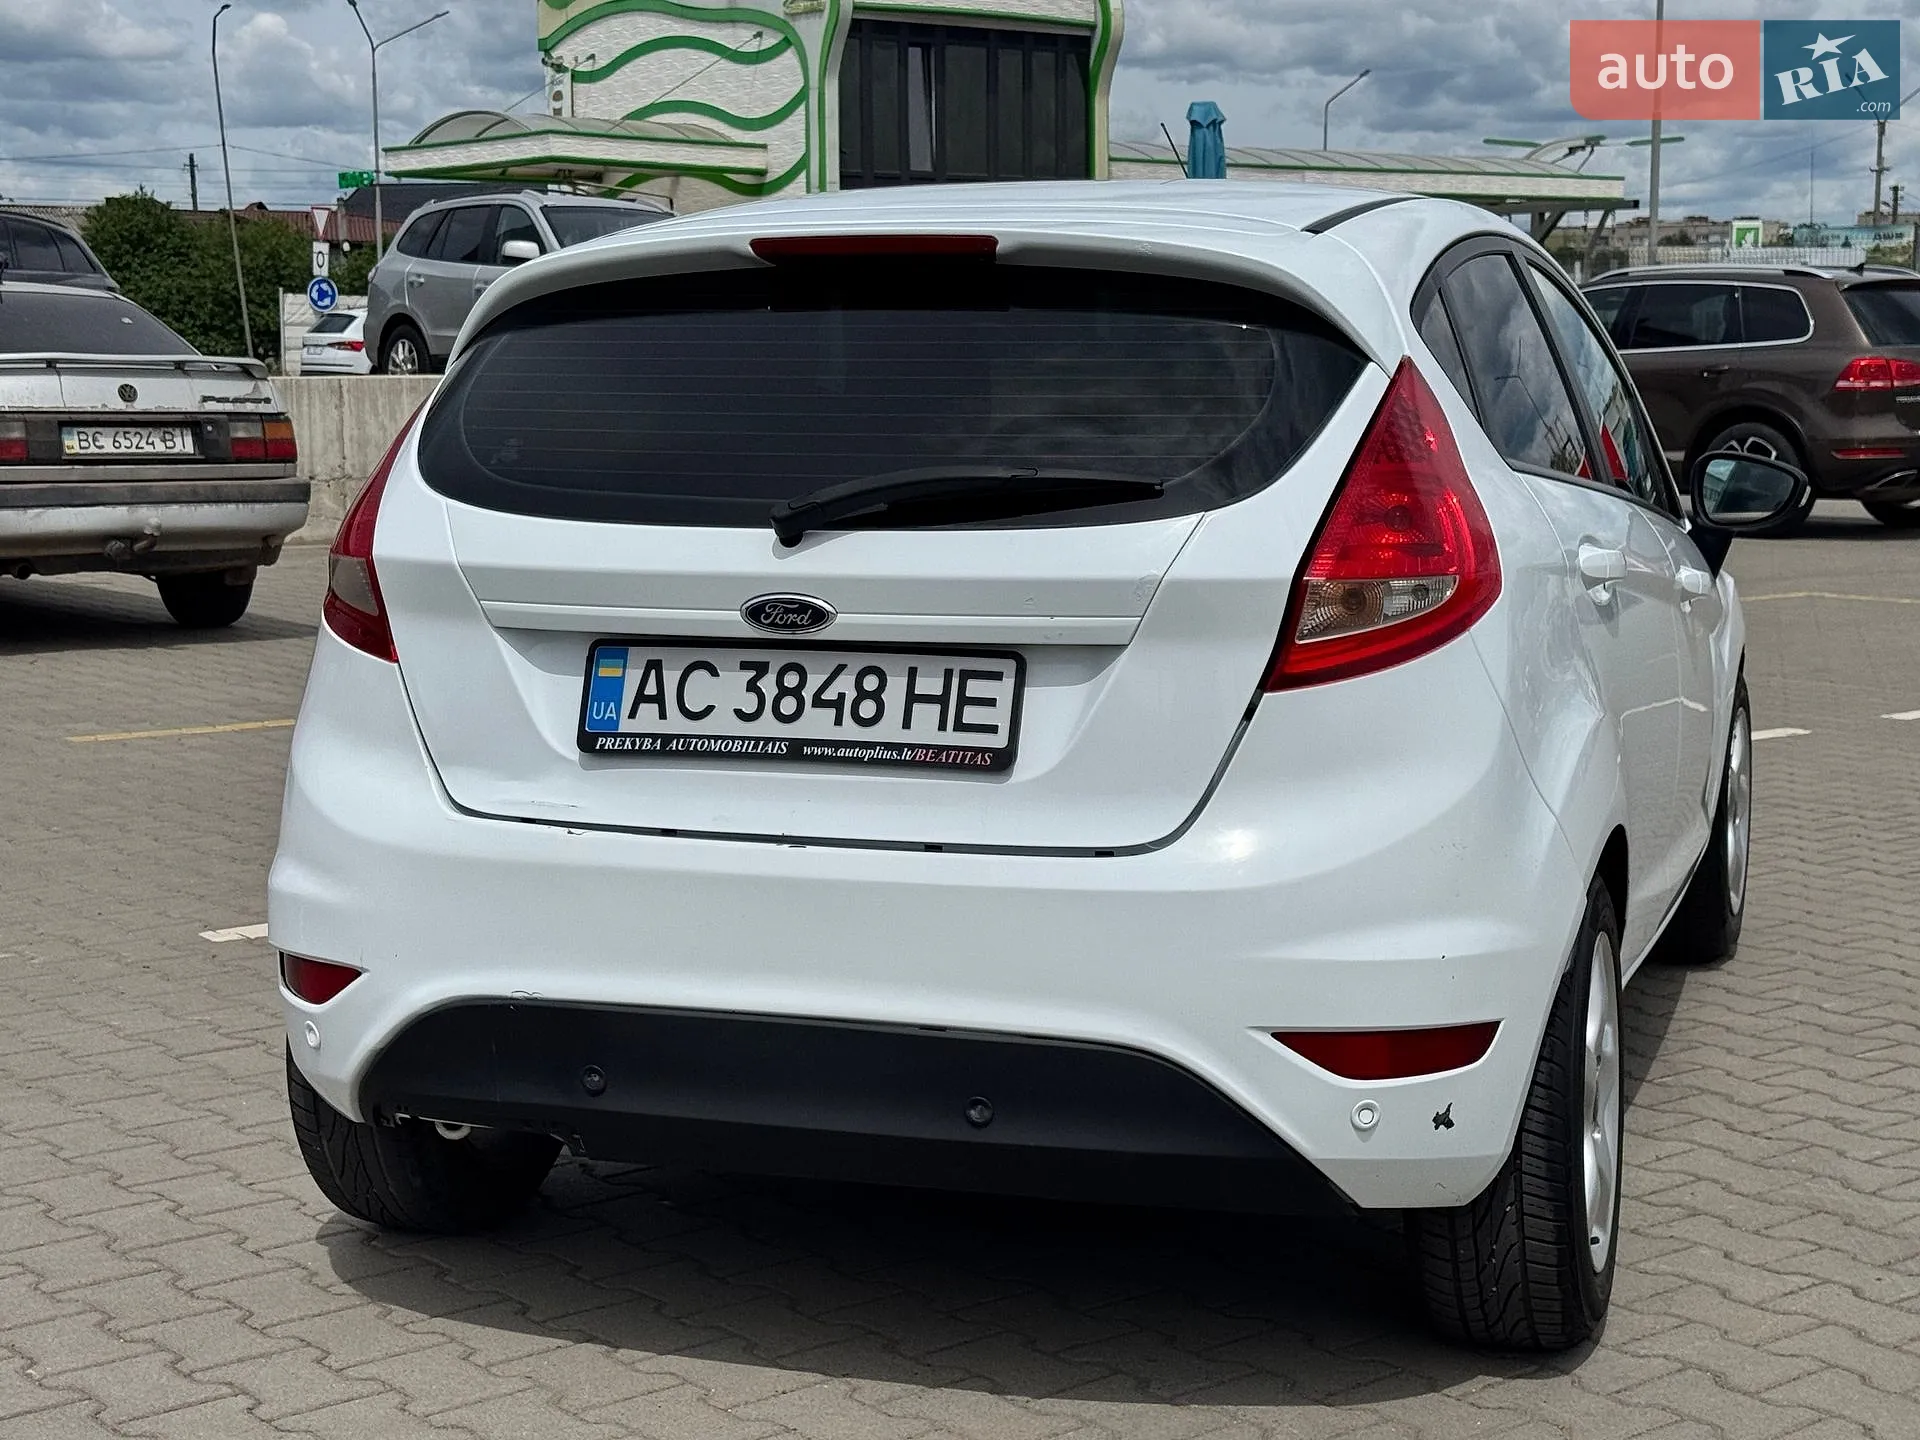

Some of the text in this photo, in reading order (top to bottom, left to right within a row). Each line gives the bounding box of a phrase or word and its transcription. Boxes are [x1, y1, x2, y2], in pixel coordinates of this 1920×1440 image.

[112, 430, 156, 450] 6524
[760, 602, 812, 627] Ford
[627, 658, 1005, 734] AC 3848 HE
[593, 701, 617, 721] UA
[594, 737, 994, 767] PREKYBA AUTOMOBILIAIS www.autoplius.lt/BEATITAS
